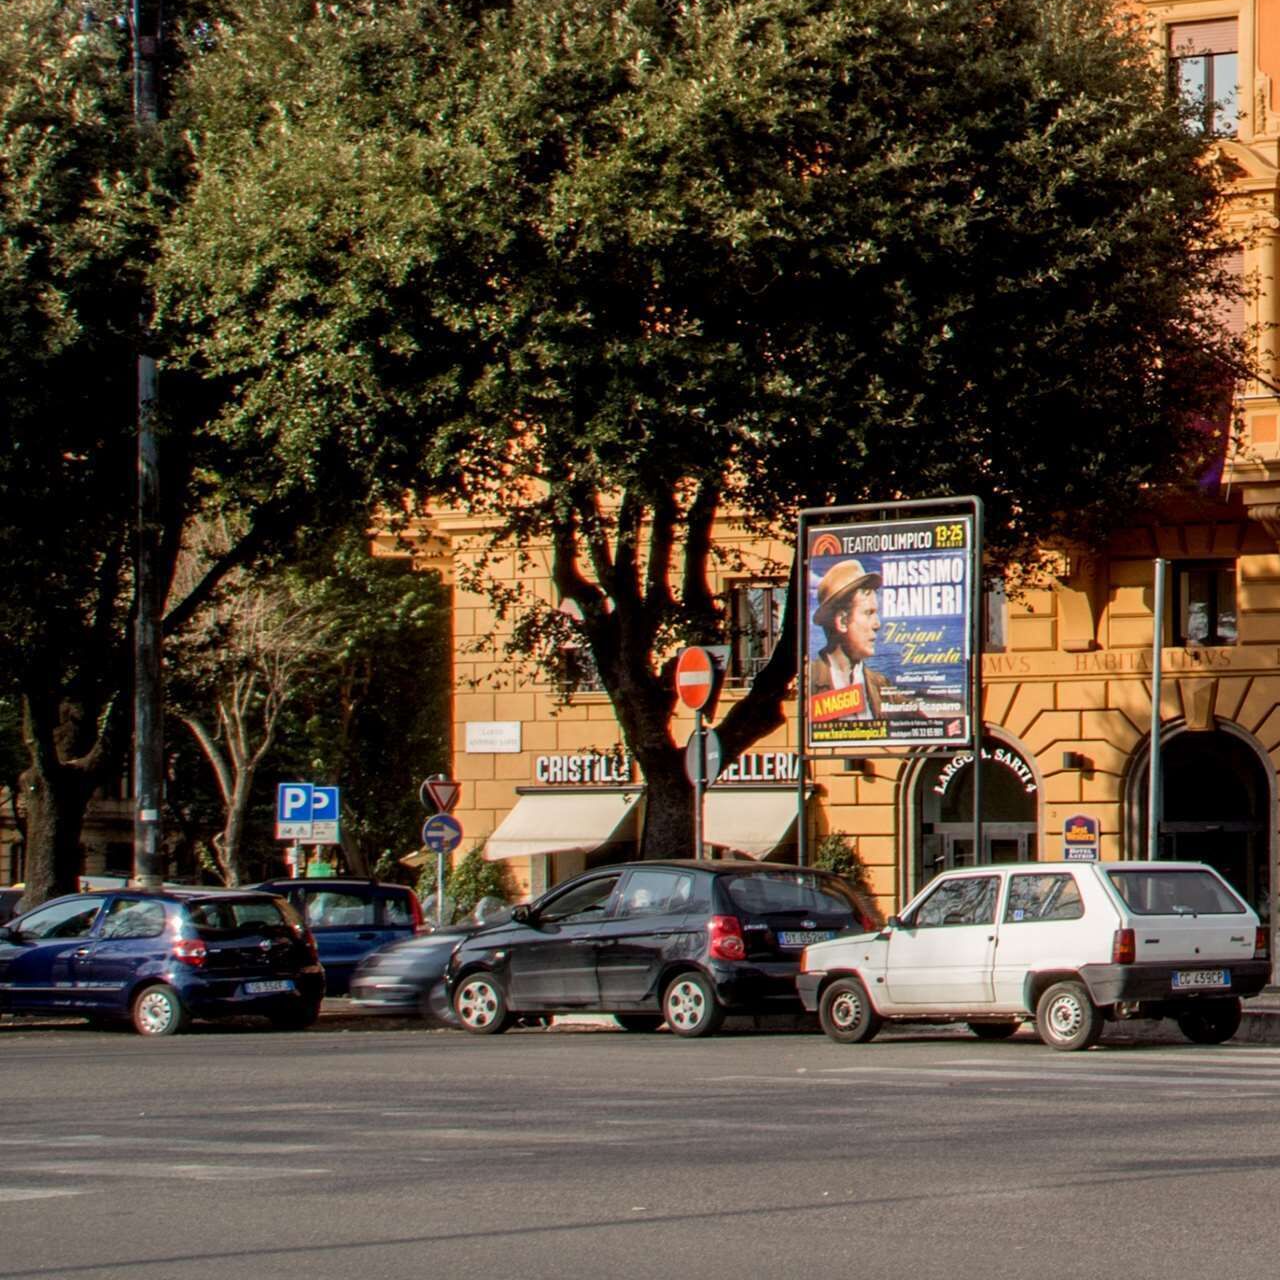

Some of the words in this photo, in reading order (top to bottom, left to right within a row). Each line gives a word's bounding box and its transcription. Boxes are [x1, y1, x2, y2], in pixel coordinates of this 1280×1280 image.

[882, 557, 963, 586] MASSIMO
[883, 585, 962, 617] RANIERI
[884, 621, 946, 644] Viviani
[814, 702, 823, 718] A
[822, 689, 860, 713] MAGGIO
[994, 748, 1033, 783] SARTI
[283, 787, 306, 819] P
